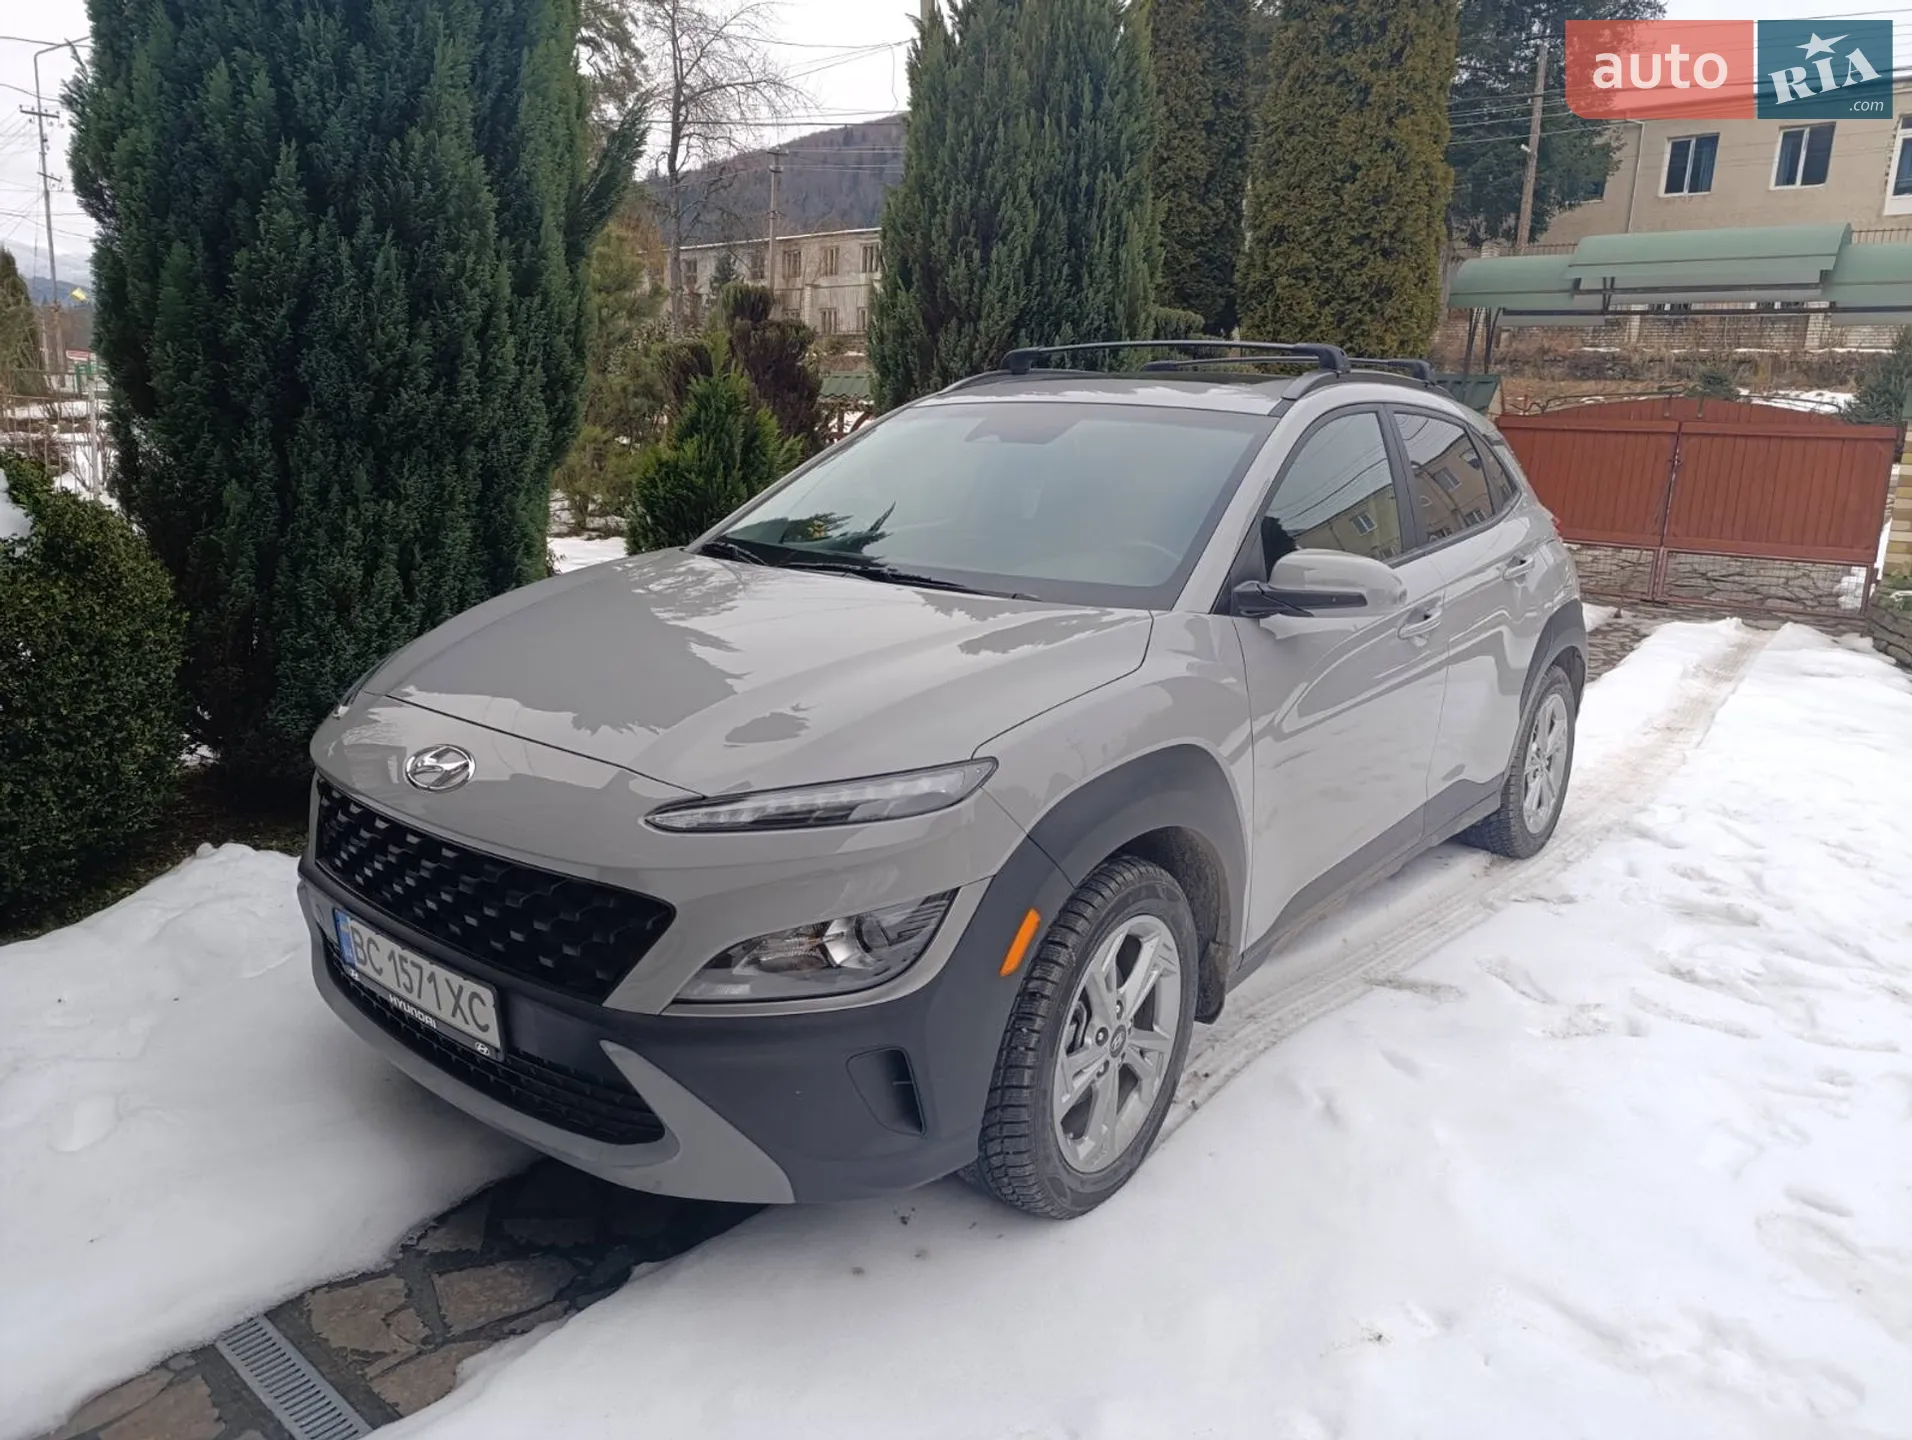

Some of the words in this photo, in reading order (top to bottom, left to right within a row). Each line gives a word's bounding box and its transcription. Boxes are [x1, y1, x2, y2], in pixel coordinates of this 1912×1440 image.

[350, 925, 384, 977] BC
[387, 949, 442, 1012] 1571
[445, 977, 490, 1033] XC
[388, 993, 437, 1029] HYUNDAI
